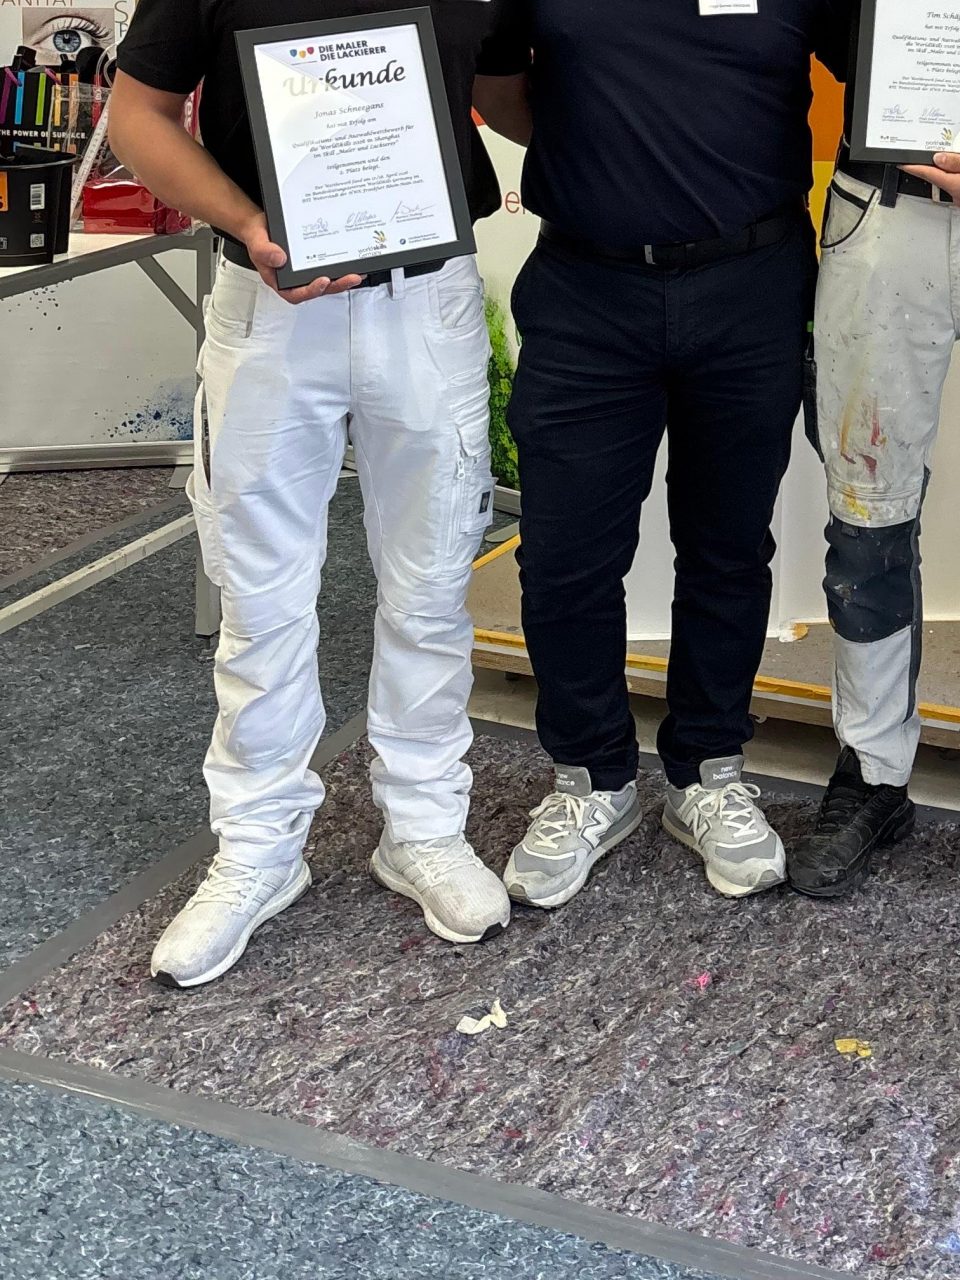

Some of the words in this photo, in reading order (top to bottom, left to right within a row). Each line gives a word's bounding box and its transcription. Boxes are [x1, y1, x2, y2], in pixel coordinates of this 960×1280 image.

[318, 44, 333, 53] DIE
[335, 39, 368, 51] MALER
[319, 52, 335, 61] DIE
[336, 45, 386, 59] LACKIERER
[282, 58, 406, 96] Urkunde
[12, 129, 39, 137] POWER
